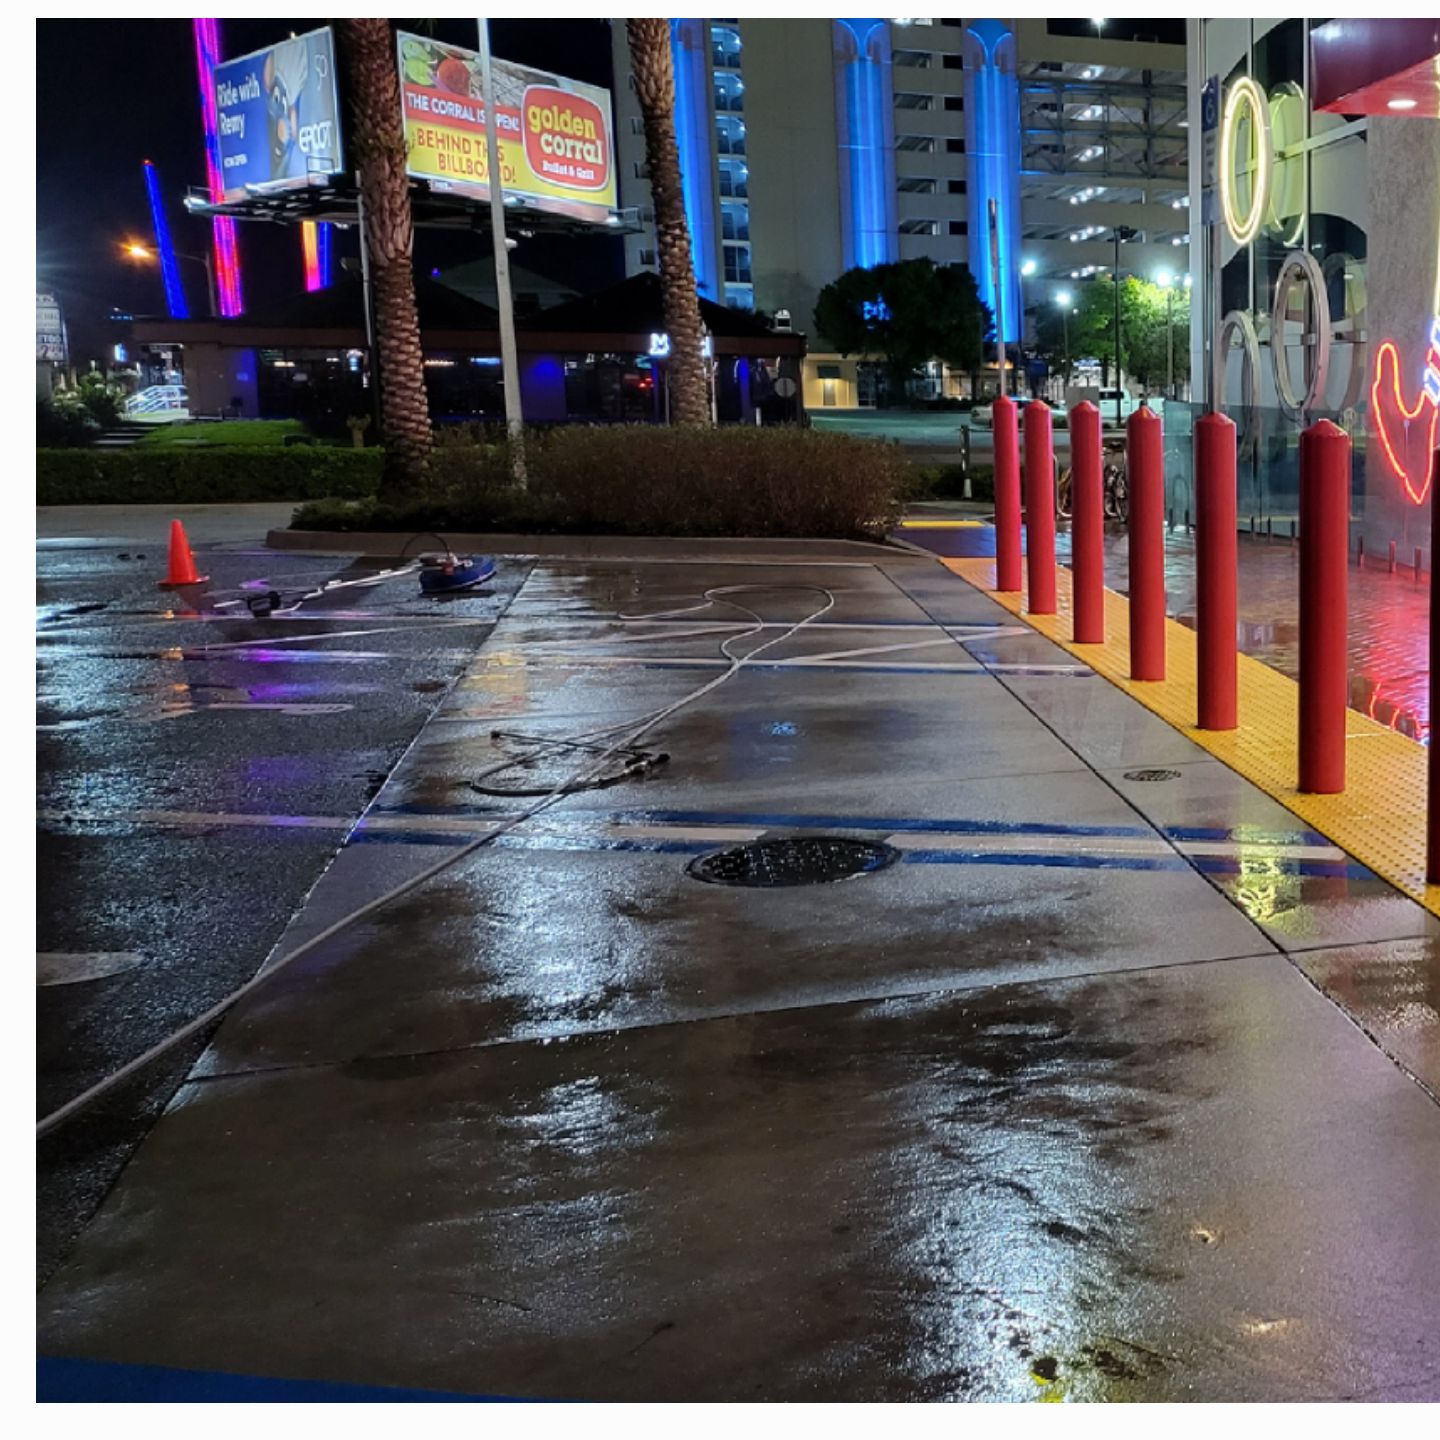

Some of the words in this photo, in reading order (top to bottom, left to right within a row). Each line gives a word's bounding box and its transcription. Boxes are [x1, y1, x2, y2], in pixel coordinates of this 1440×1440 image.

[216, 79, 237, 108] Ride
[238, 72, 260, 100] with
[406, 92, 430, 110] THE
[430, 98, 474, 123] CORRAL
[495, 113, 520, 132] PEN!
[527, 104, 596, 140] golden
[416, 128, 472, 156] BEHIND
[473, 139, 505, 162] THS
[540, 133, 604, 165] corral
